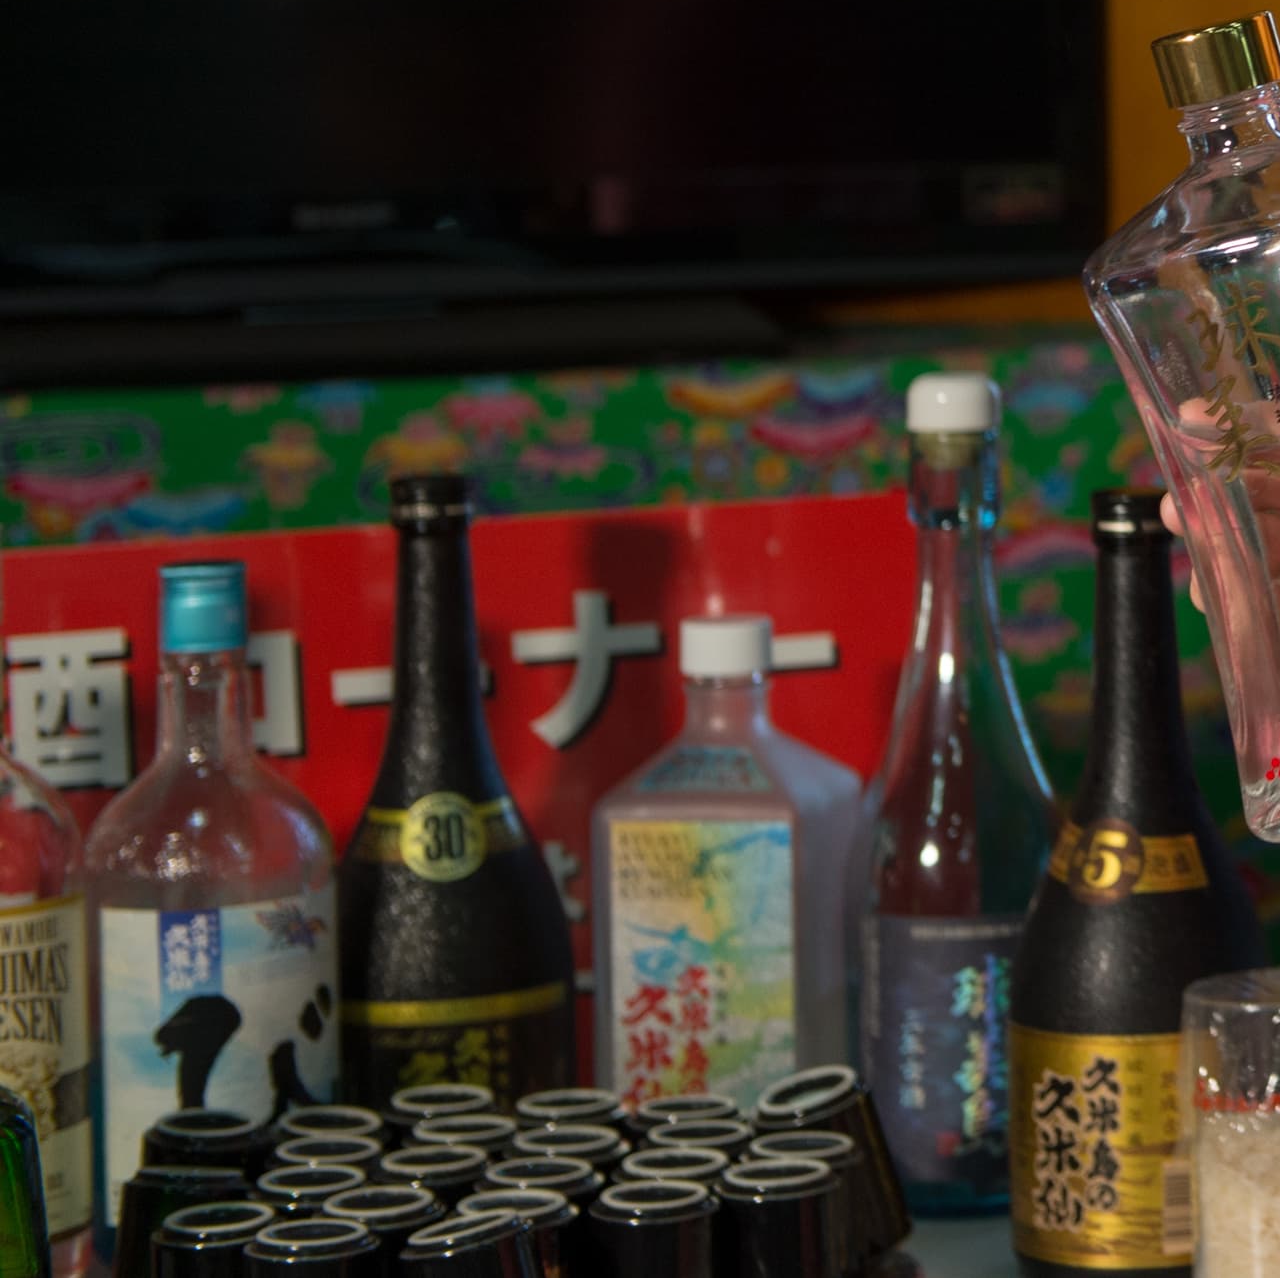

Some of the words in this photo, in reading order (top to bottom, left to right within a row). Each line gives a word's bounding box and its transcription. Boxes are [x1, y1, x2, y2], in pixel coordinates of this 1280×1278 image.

[423, 814, 466, 862] 30
[1081, 829, 1129, 889] 5
[1034, 1072, 1084, 1225] 久米仙
[1082, 1056, 1122, 1210] 久米島の
